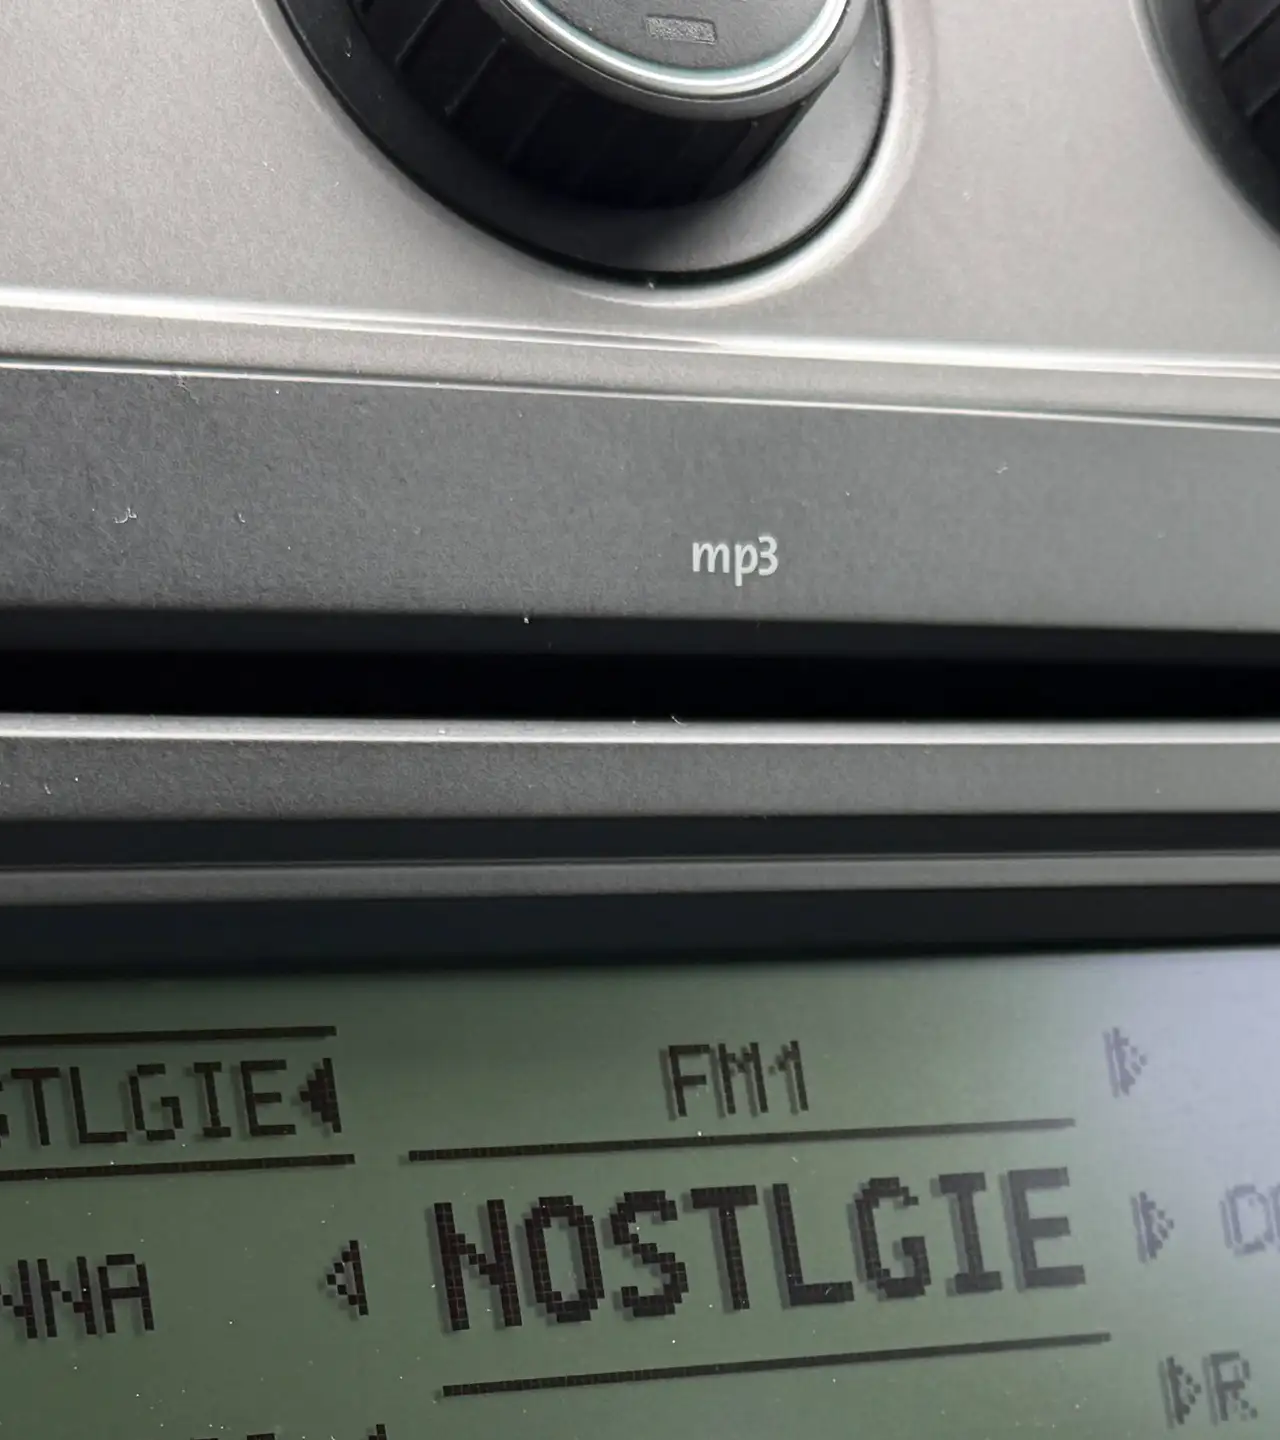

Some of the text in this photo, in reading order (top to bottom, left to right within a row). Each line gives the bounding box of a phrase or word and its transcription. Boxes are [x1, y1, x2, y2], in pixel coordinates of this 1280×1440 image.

[691, 534, 780, 587] mp3
[659, 1039, 810, 1120] FM1
[426, 1165, 1087, 1332] NOSTLGIE
[1202, 1350, 1258, 1426] R
